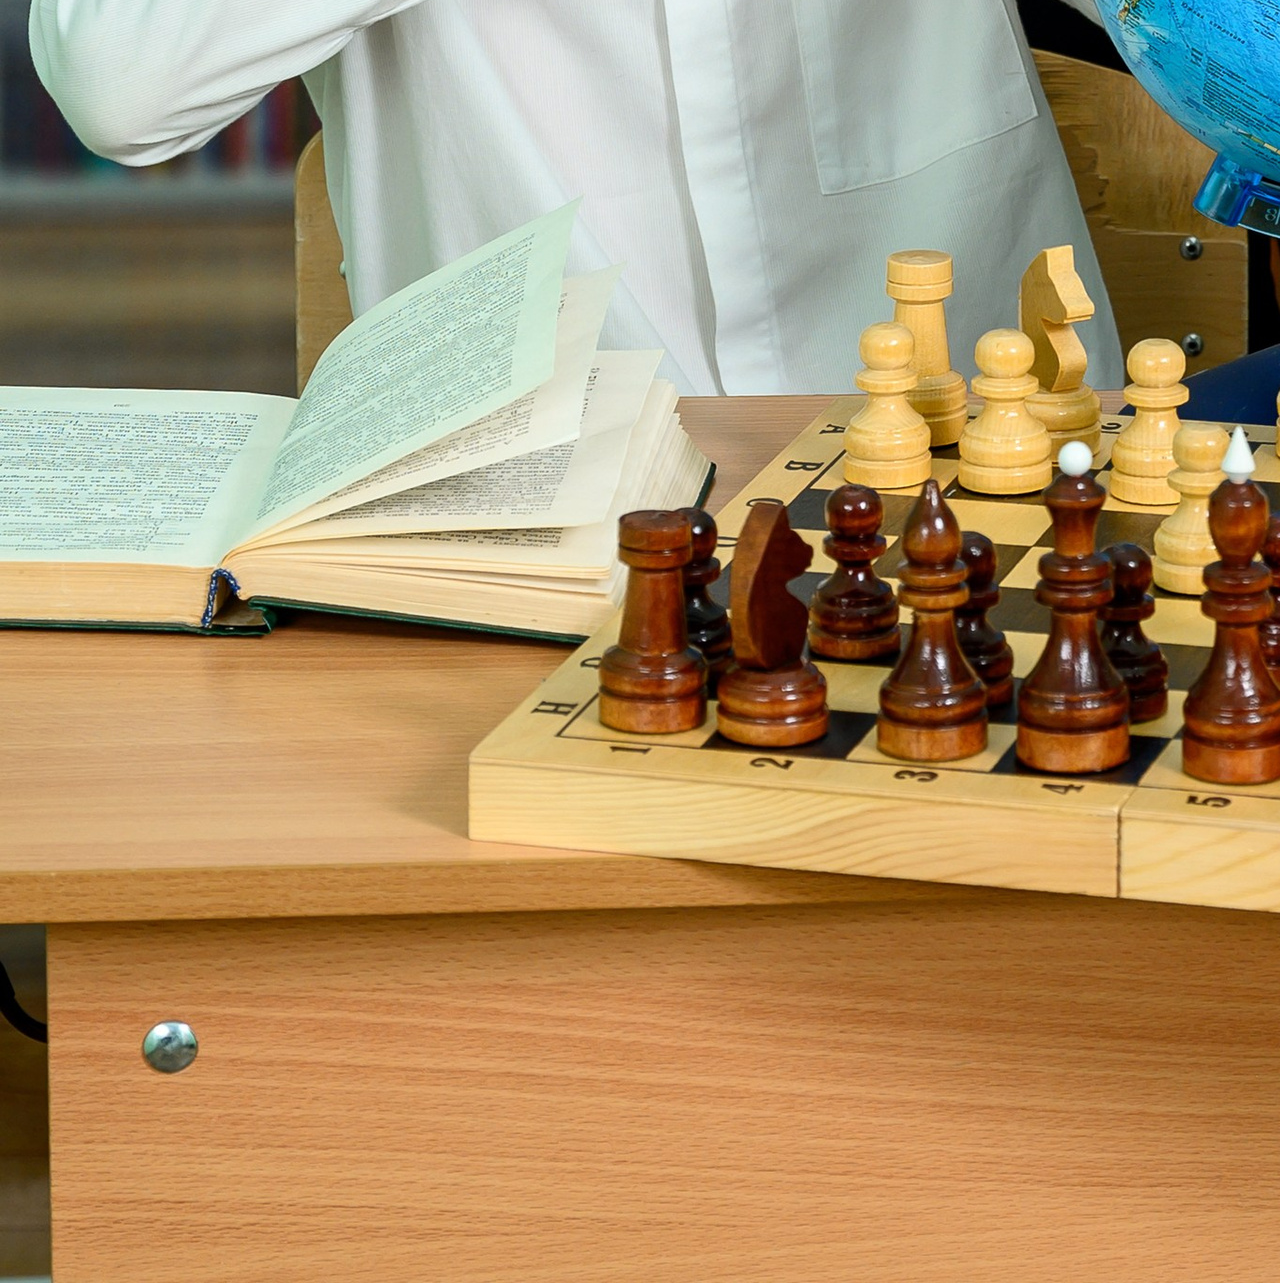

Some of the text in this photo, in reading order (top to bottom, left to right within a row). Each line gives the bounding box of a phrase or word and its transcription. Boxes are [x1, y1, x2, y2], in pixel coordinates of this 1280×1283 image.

[785, 459, 824, 472] B
[531, 700, 578, 717] H
[610, 745, 651, 755] 1
[750, 757, 793, 771] 2
[893, 769, 940, 784] 3
[1040, 782, 1085, 796] 4
[1186, 794, 1233, 809] 5
